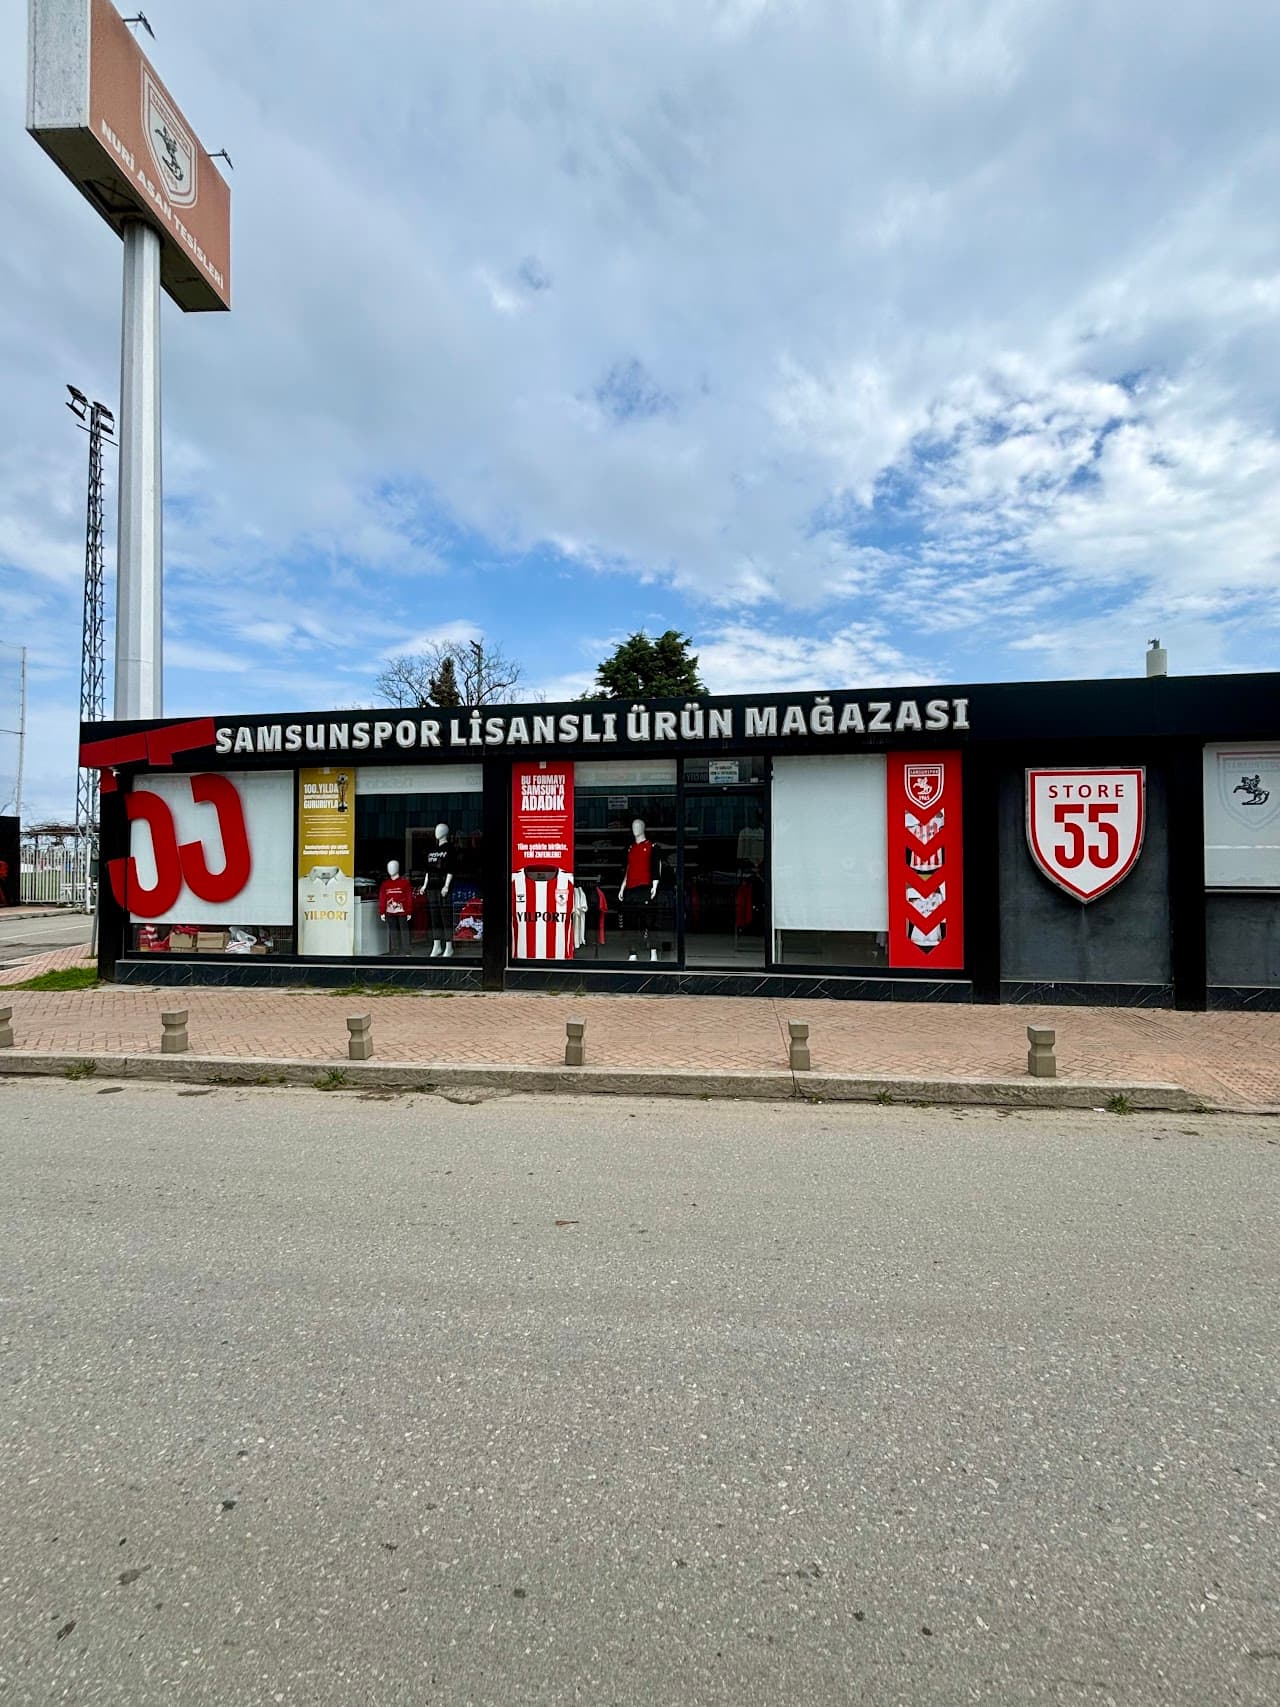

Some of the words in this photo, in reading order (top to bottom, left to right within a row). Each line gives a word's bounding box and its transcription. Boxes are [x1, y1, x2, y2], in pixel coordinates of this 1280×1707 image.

[102, 119, 135, 173] NURİ
[137, 170, 173, 220] ASAN
[173, 214, 225, 289] TESİSLERİ
[215, 719, 441, 753] SAMSUNSPOR
[450, 710, 618, 747] LİSANSLI
[626, 702, 733, 742] ÜRÜN
[744, 696, 970, 738] MAĞAZASI
[533, 775, 566, 785] FORMAYI
[521, 785, 565, 796] SAMSUN'A
[1048, 784, 1125, 799] STORE
[521, 796, 566, 811] ADADIK
[1053, 804, 1119, 869] 55
[304, 911, 348, 921] YILPORT
[517, 911, 567, 922] YILPORT
